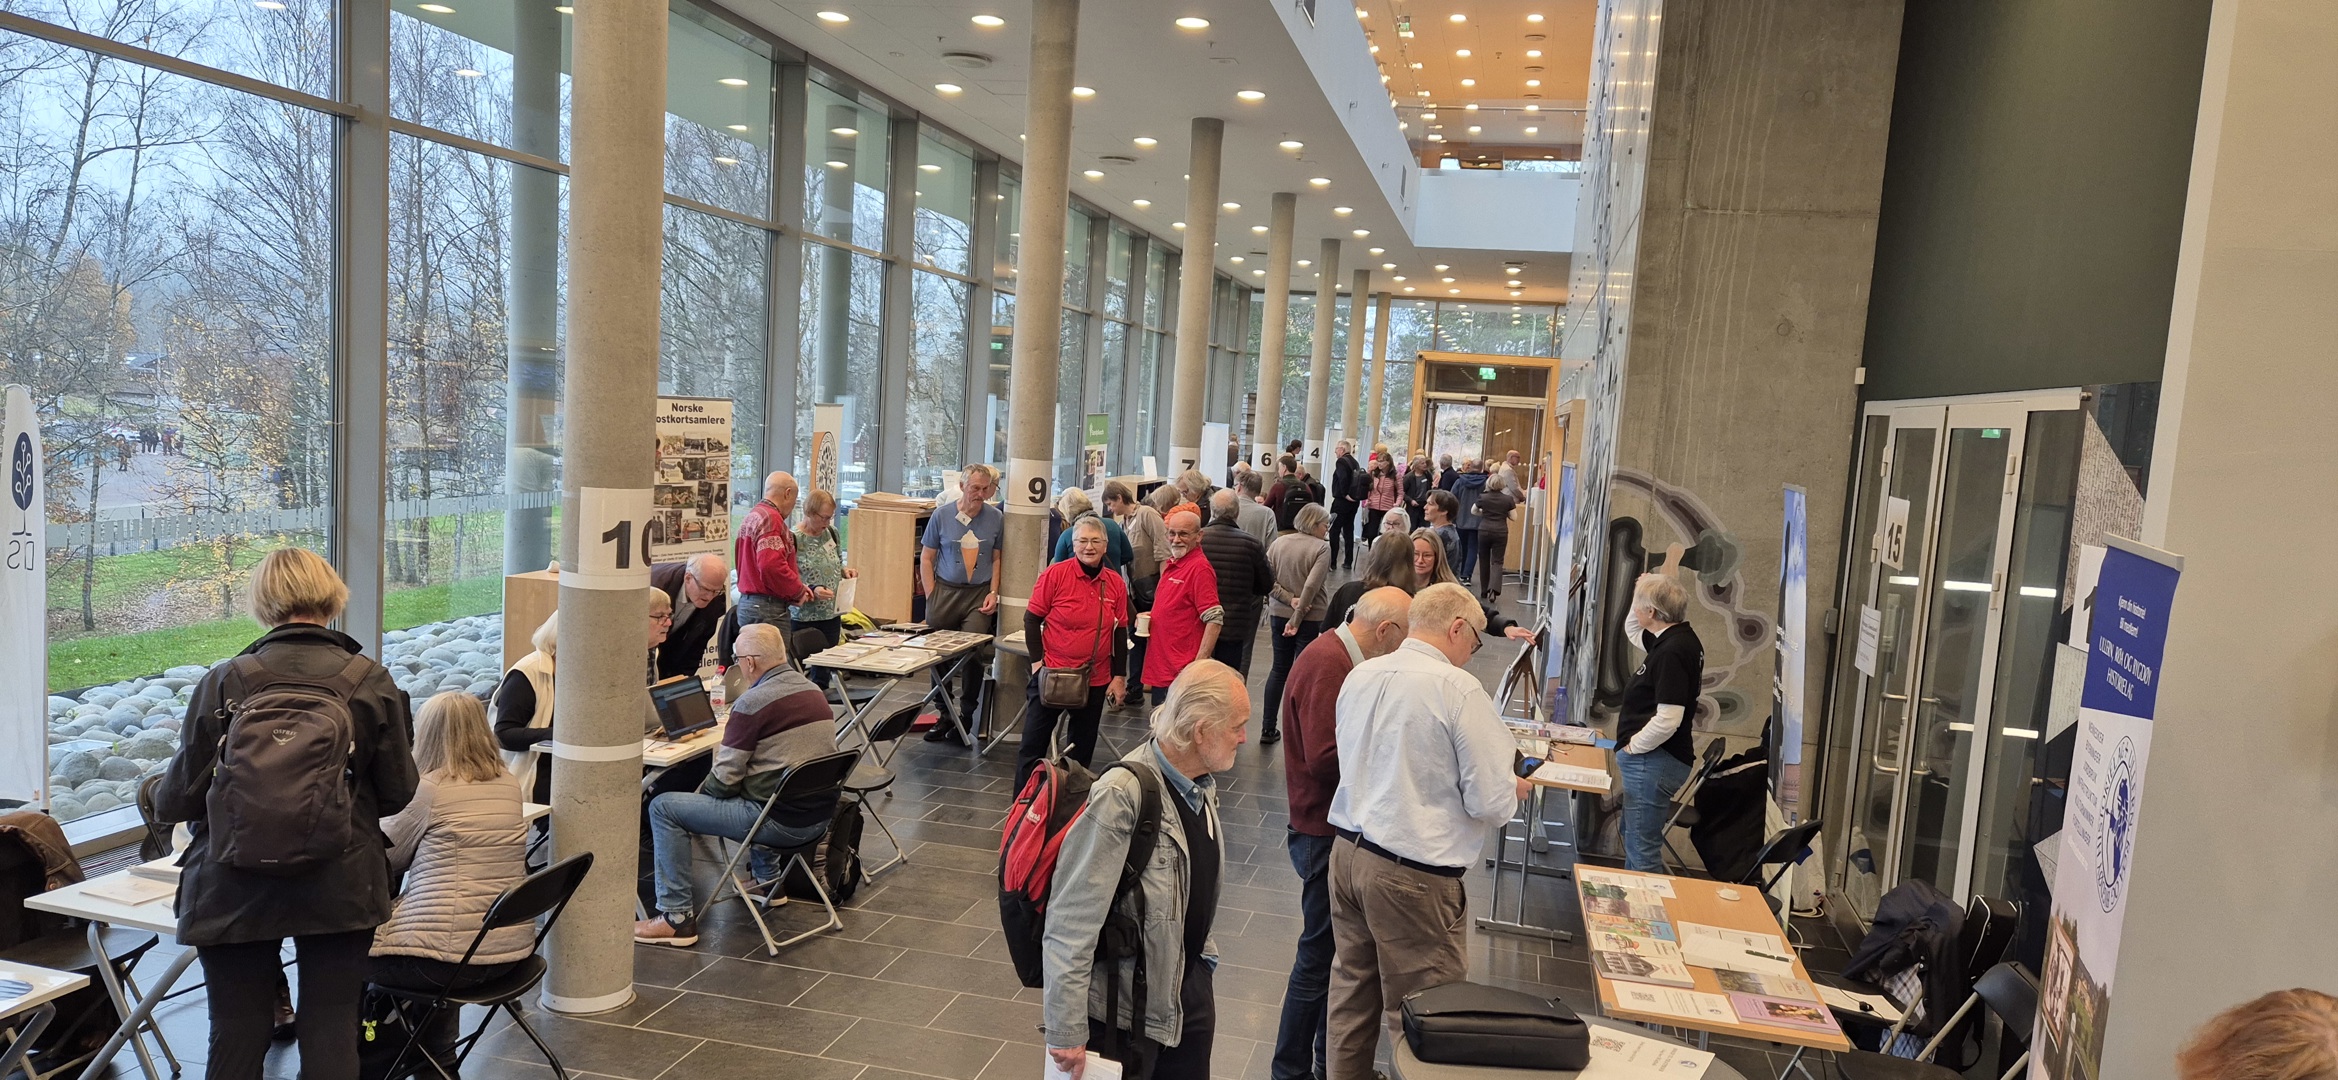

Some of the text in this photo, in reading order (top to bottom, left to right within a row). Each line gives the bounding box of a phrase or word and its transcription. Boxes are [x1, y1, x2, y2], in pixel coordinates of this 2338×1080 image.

[671, 403, 704, 413] Norske
[655, 414, 726, 424] ostkortsamlere
[1261, 452, 1272, 467] 6
[1310, 447, 1320, 458] 4
[1181, 459, 1196, 470] 7
[1028, 477, 1047, 503] 9
[1887, 522, 1903, 563] 15
[2124, 653, 2133, 673] OG
[2106, 667, 2134, 702] HISTORIELAG
